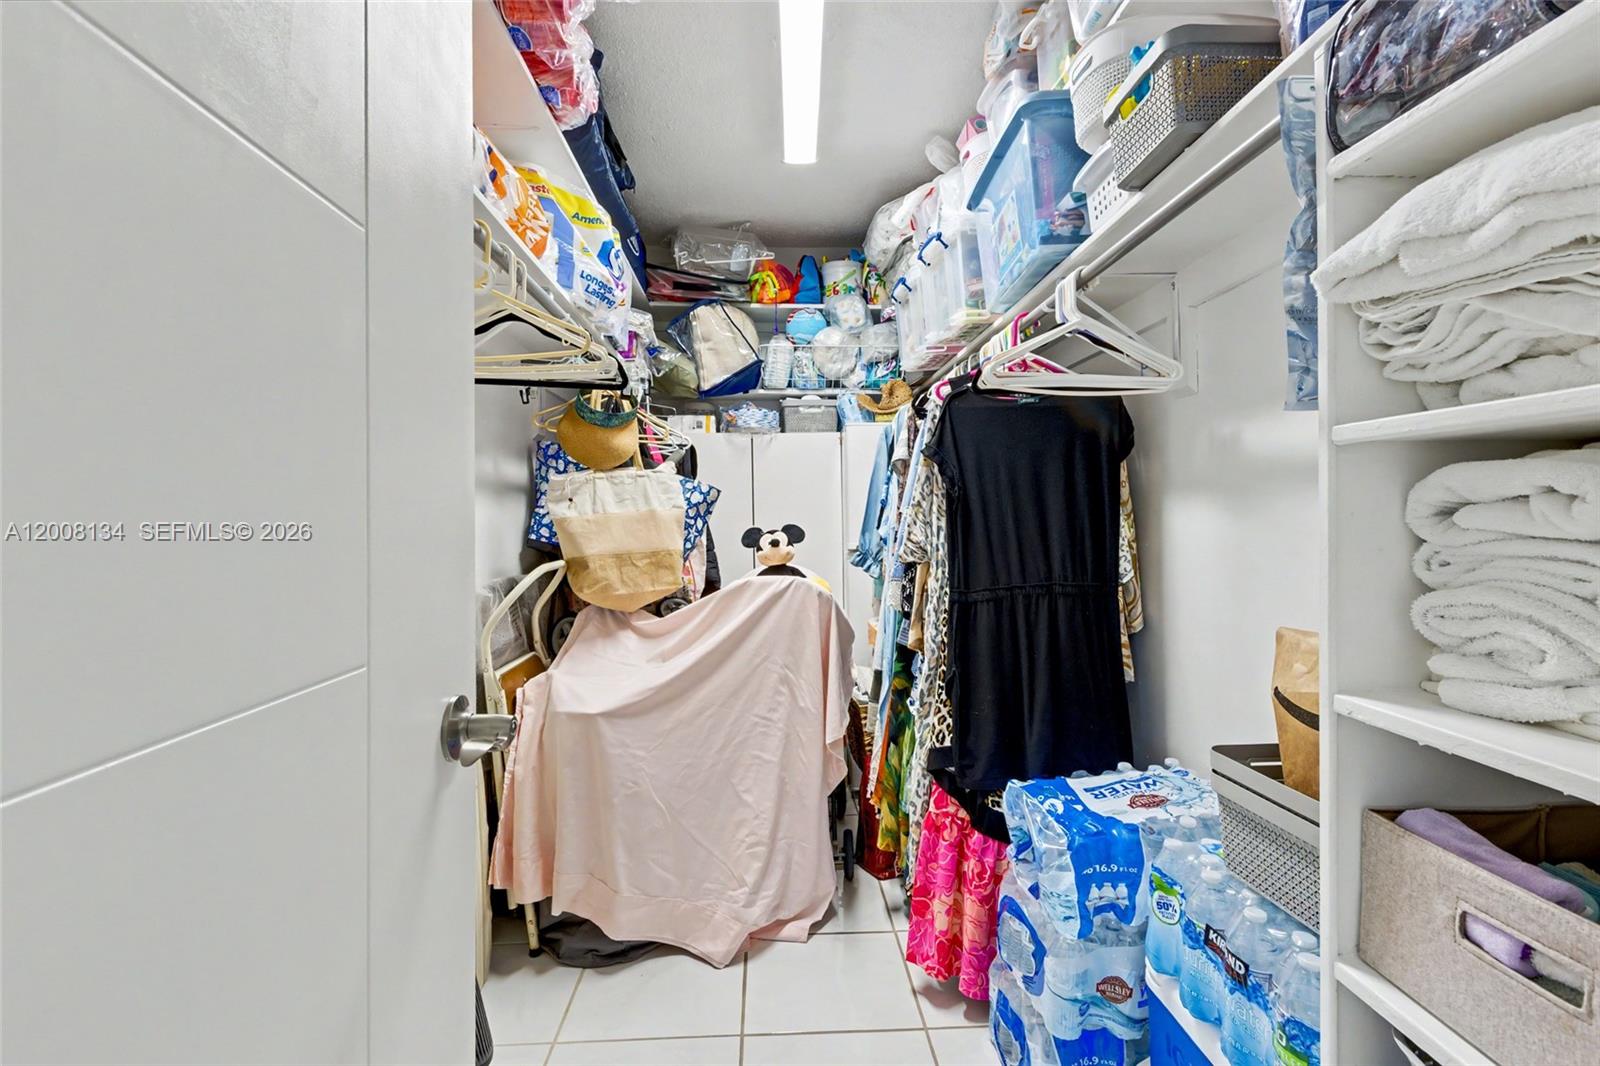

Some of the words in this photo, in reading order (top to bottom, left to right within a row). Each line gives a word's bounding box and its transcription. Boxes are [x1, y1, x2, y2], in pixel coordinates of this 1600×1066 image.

[1090, 779, 1158, 799] WATER
[1093, 863, 1118, 873] 16.9
[1156, 901, 1178, 914] 50%
